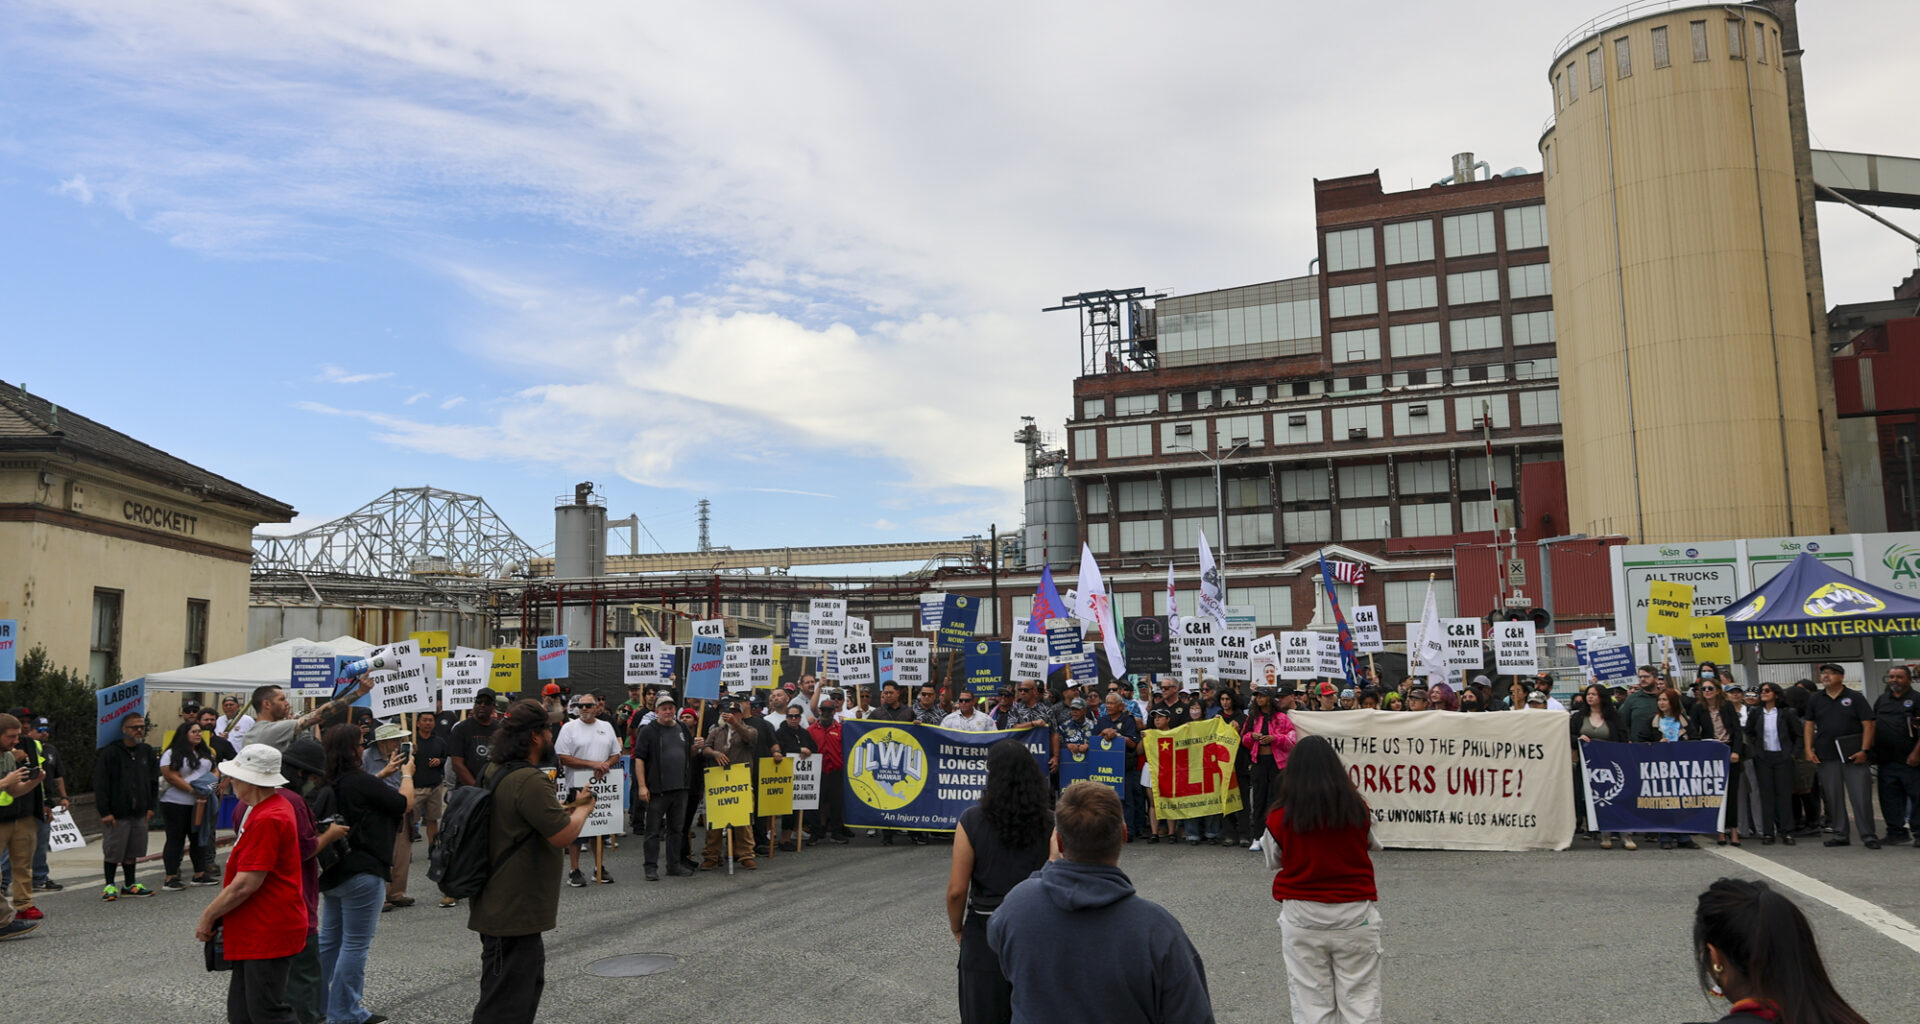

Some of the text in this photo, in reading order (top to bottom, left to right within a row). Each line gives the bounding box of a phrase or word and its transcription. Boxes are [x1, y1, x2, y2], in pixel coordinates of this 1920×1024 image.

[122, 500, 198, 536] CROCKETT
[1645, 571, 1718, 582] ALL TRUCKS
[1652, 598, 1690, 609] SUPPORT
[1806, 588, 1879, 615] ILWU
[1356, 612, 1373, 622] C&H
[1659, 610, 1679, 618] ILWU
[698, 625, 719, 635] C&H
[941, 628, 973, 636] CONTRACT
[1186, 623, 1211, 634] C&H
[1356, 625, 1378, 633] UNFAIR
[1448, 625, 1474, 636] C&H
[1505, 628, 1524, 638] C&H
[1747, 624, 1798, 640] ILWU
[541, 639, 564, 648] LABOR
[1184, 638, 1215, 646] UNFAIR
[1221, 636, 1245, 647] C&H
[1253, 640, 1272, 654] C&H
[1290, 637, 1307, 646] C&H
[398, 645, 410, 655] ON
[634, 643, 651, 652] C&H
[697, 642, 721, 656] LABOR
[843, 643, 866, 654] C&H
[1792, 644, 1831, 655] TURN
[1218, 650, 1248, 659] UNFAIR
[840, 656, 870, 666] UNFAIR
[387, 668, 420, 682] UNFAIRLY
[384, 682, 409, 696] FIRING
[104, 684, 139, 706] LABOR
[383, 694, 418, 709] STRIKERS
[1352, 737, 1544, 759] THE US TO THE PHILIPPINES
[796, 761, 812, 771] C&H
[853, 742, 922, 781] ILWU
[1640, 760, 1724, 779] KABATAAN
[589, 776, 606, 784] ON
[761, 776, 792, 784] SUPPORT
[938, 774, 986, 785] WAREH
[1090, 775, 1123, 783] CONTRACT
[1344, 764, 1523, 798] ORKERS UNITE!
[1587, 768, 1616, 784] KA
[708, 784, 749, 796] SUPPORT
[1640, 777, 1724, 797] ALLIANCE
[938, 788, 982, 800] UNION
[718, 797, 739, 806] ILWU
[1637, 796, 1680, 809] NORTHERN
[897, 813, 919, 824] Injury
[1388, 809, 1445, 824] UNYONISTA
[1450, 811, 1463, 825] NG
[1468, 812, 1486, 826] LOS
[1491, 814, 1536, 828] ANGELES
[52, 833, 77, 844] C&H
